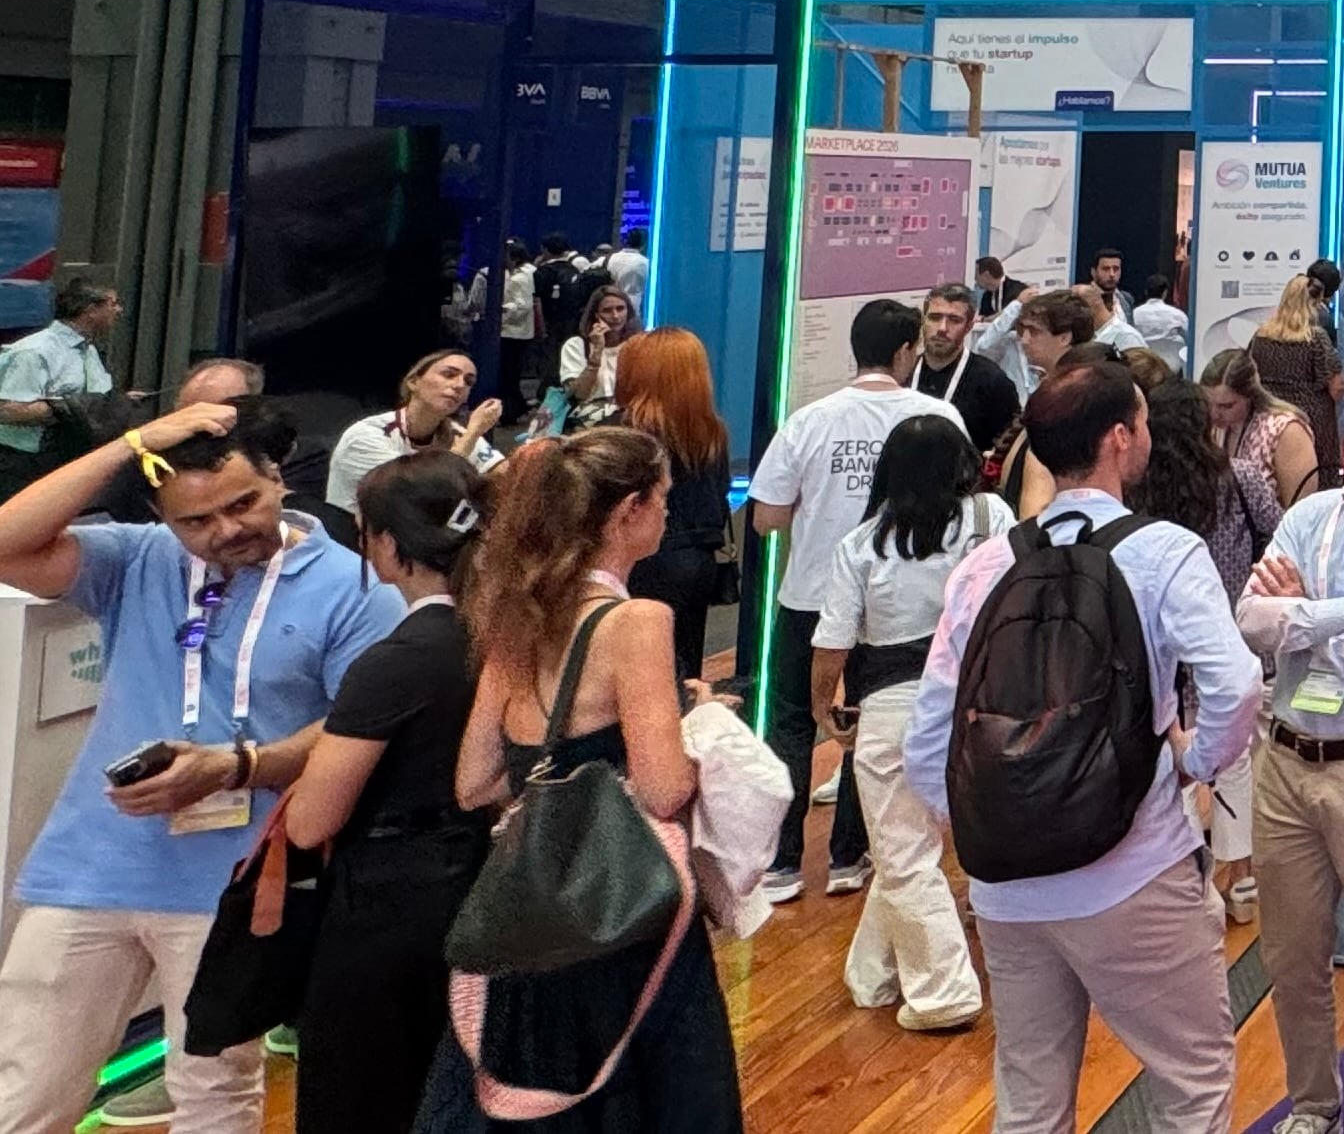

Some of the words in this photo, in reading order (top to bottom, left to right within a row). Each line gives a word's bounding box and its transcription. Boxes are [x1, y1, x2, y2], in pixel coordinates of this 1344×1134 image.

[1028, 33, 1079, 46] impulso
[988, 49, 1034, 61] startup
[580, 86, 611, 100] BBVA
[806, 136, 875, 152] MARKETPLACE
[1255, 162, 1306, 176] MUTUA
[1255, 178, 1307, 189] Ventures
[832, 440, 884, 458] ZERO
